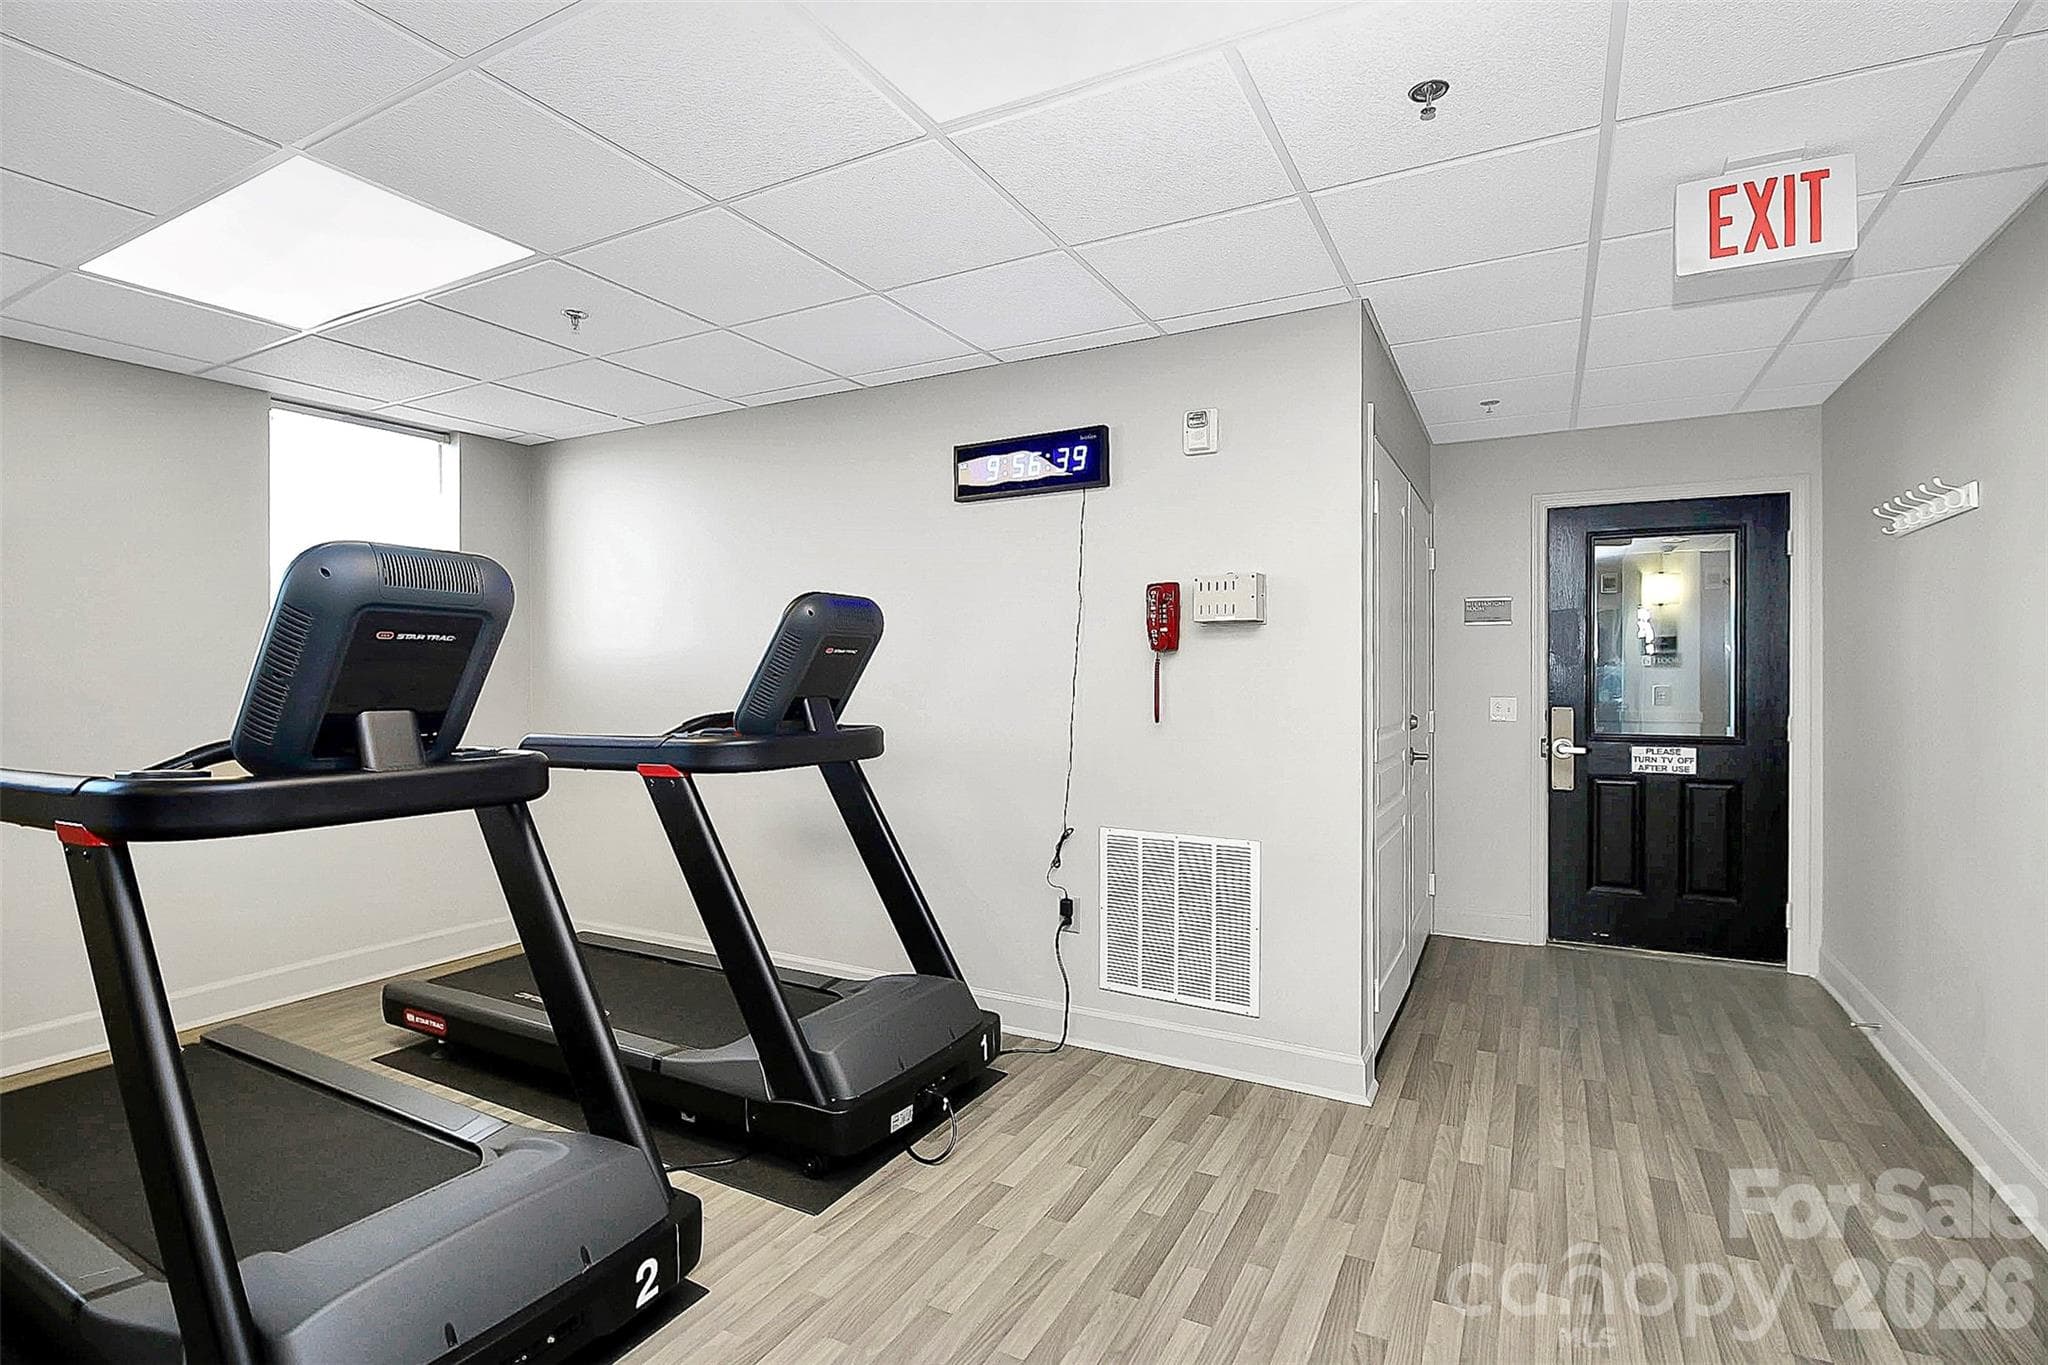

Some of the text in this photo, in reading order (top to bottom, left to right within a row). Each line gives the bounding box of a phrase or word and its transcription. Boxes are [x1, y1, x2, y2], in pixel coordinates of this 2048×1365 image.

[1709, 168, 1830, 259] EXIT
[986, 445, 1088, 482] 9:56:39
[396, 633, 426, 641] STAR
[1633, 755, 1695, 765] TURN TV OFF
[1645, 748, 1681, 756] PLEASE
[1638, 764, 1690, 773] AFTER USE
[981, 1034, 988, 1061] 1
[635, 1257, 659, 1310] 2
